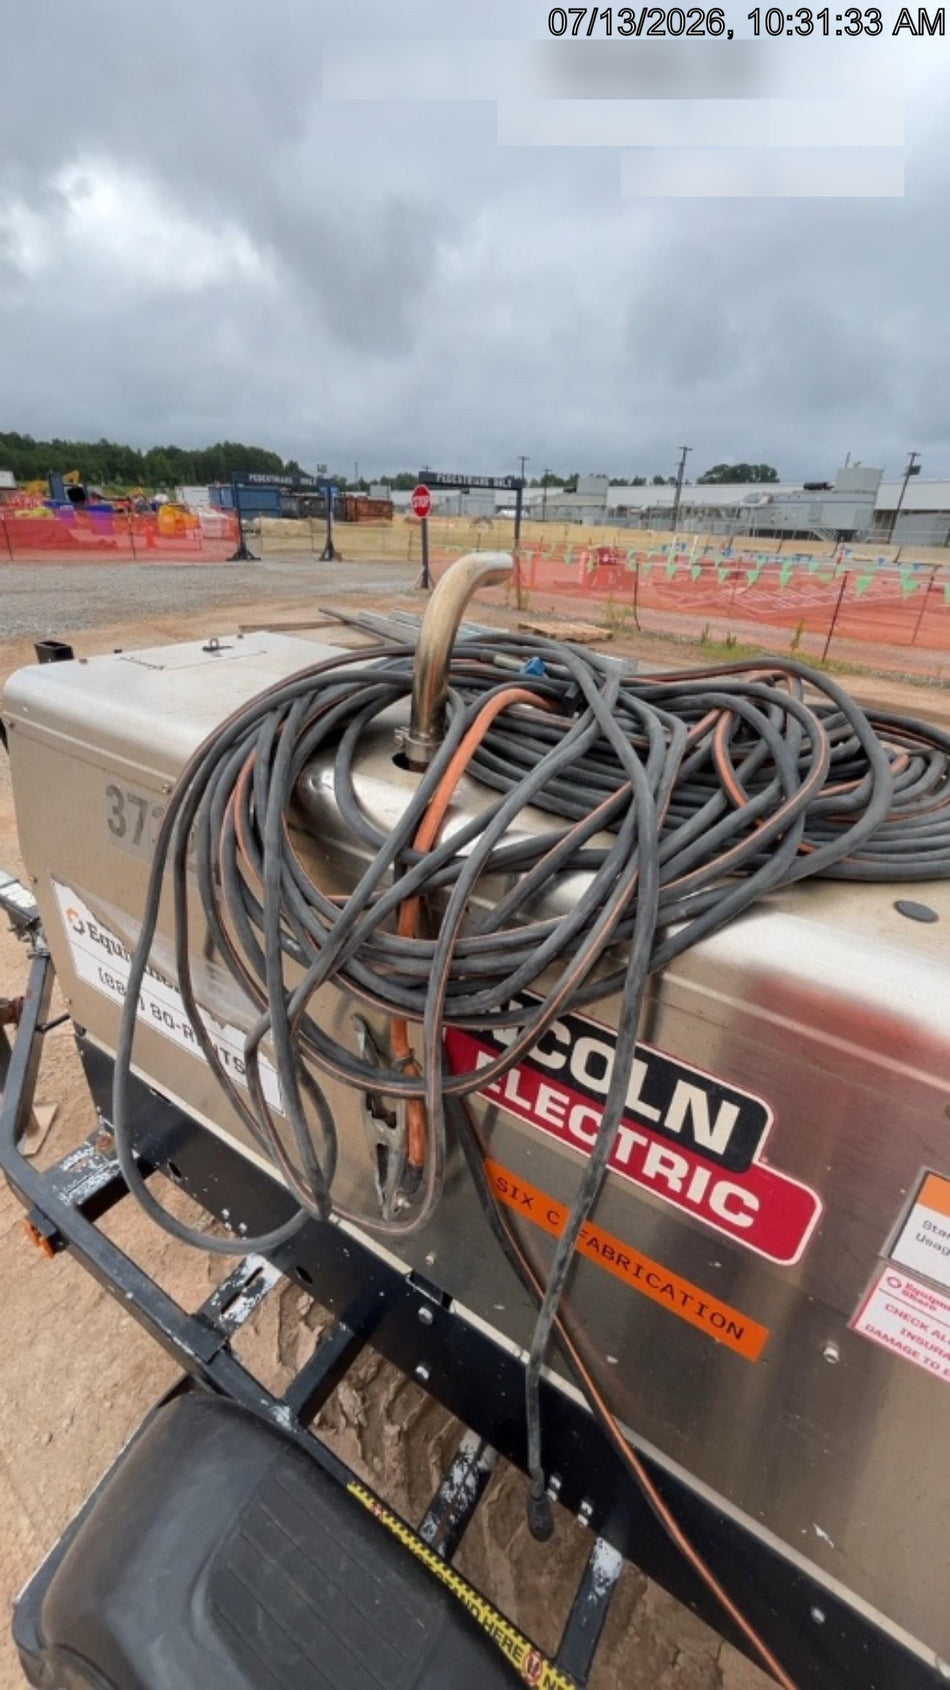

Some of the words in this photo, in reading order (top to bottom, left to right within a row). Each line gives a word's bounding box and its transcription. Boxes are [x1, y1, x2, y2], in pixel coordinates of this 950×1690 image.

[412, 494, 430, 508] STOP
[150, 1002, 247, 1076] 80-RTS
[483, 998, 741, 1157] COLN
[496, 1176, 534, 1211] SIX
[865, 1323, 920, 1359] DAMAGE
[923, 1356, 940, 1370] TO
[885, 1303, 930, 1332] CHECK
[931, 1329, 950, 1346] AL
